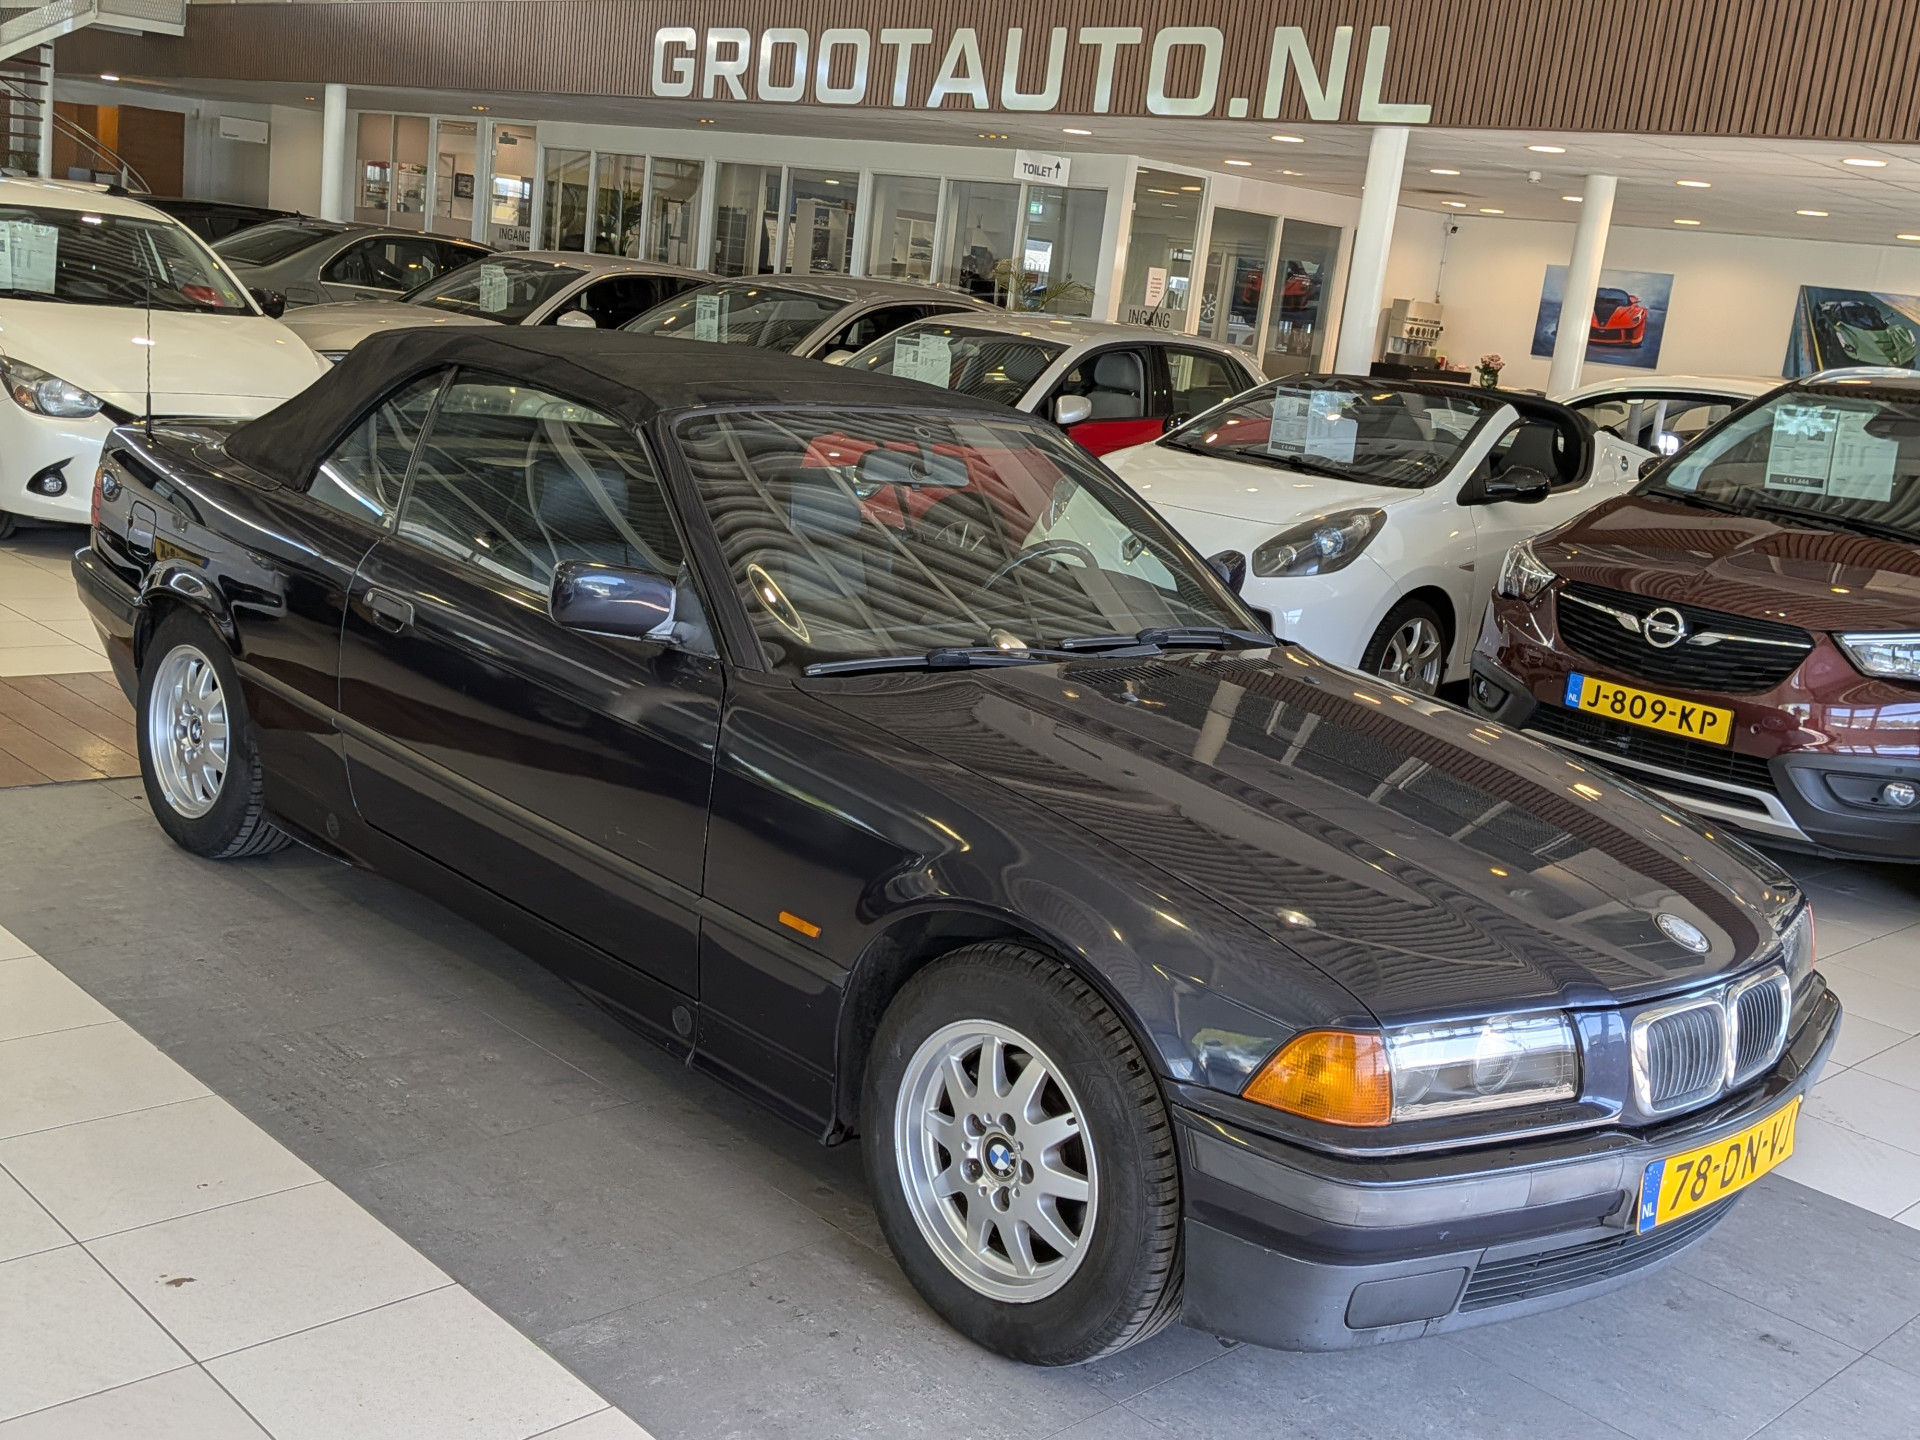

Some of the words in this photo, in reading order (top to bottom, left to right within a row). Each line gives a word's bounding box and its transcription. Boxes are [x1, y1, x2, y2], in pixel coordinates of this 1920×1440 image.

[652, 26, 1432, 124] GROOTAUTO.NL
[1022, 162, 1053, 178] TOILET
[499, 227, 531, 243] INGANG
[1128, 308, 1171, 329] INGANG
[1568, 693, 1579, 703] NL
[1586, 684, 1718, 735] J-809-KP
[1668, 1107, 1795, 1212] 78-DN-VJ
[1641, 1200, 1655, 1220] NL
